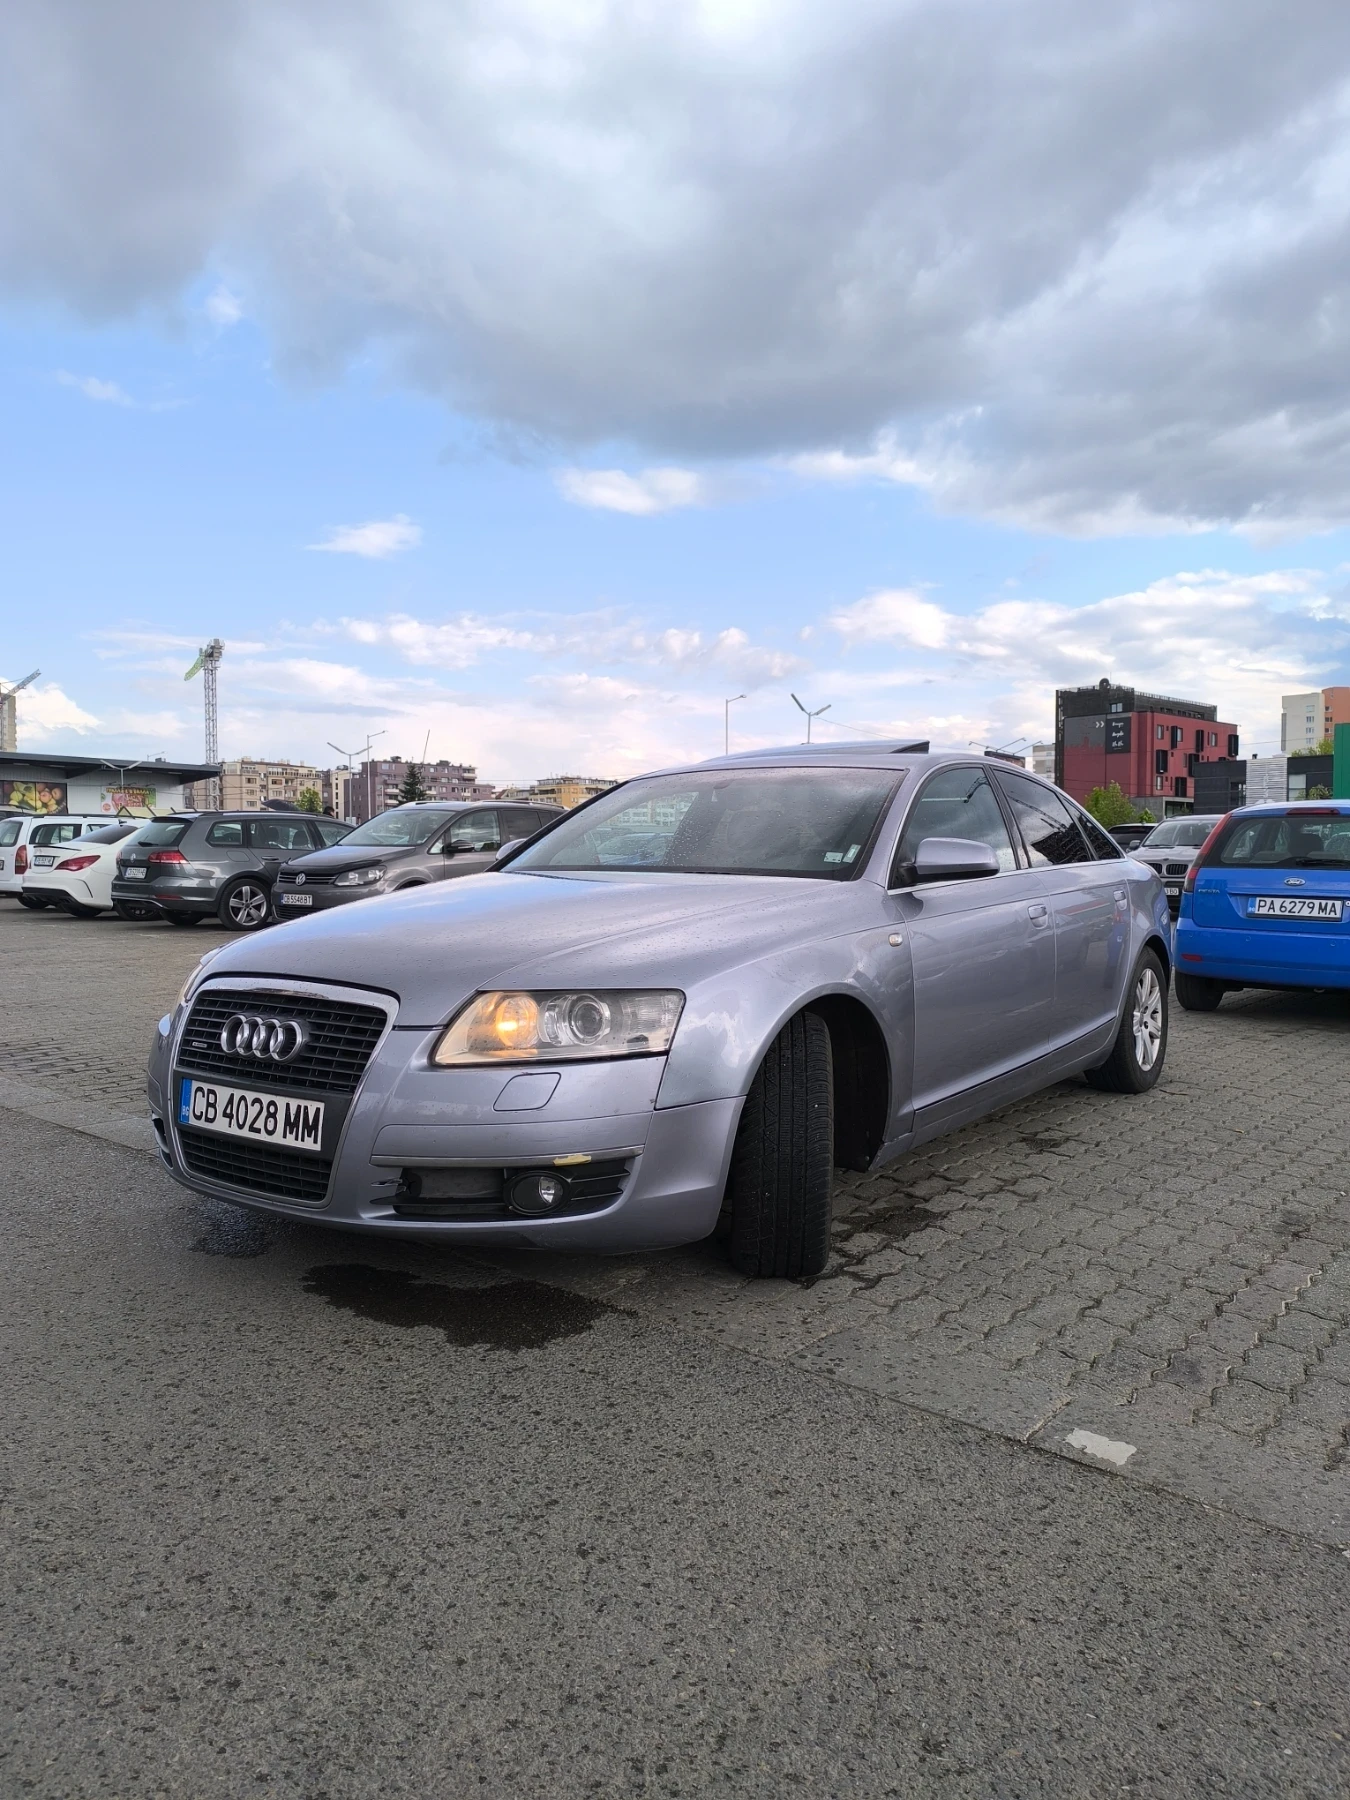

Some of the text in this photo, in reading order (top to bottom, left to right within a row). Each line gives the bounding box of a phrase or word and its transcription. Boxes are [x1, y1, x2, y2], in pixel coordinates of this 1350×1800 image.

[1257, 899, 1337, 915] PA 6279 MA
[192, 1086, 321, 1145] CB 4028 MM
